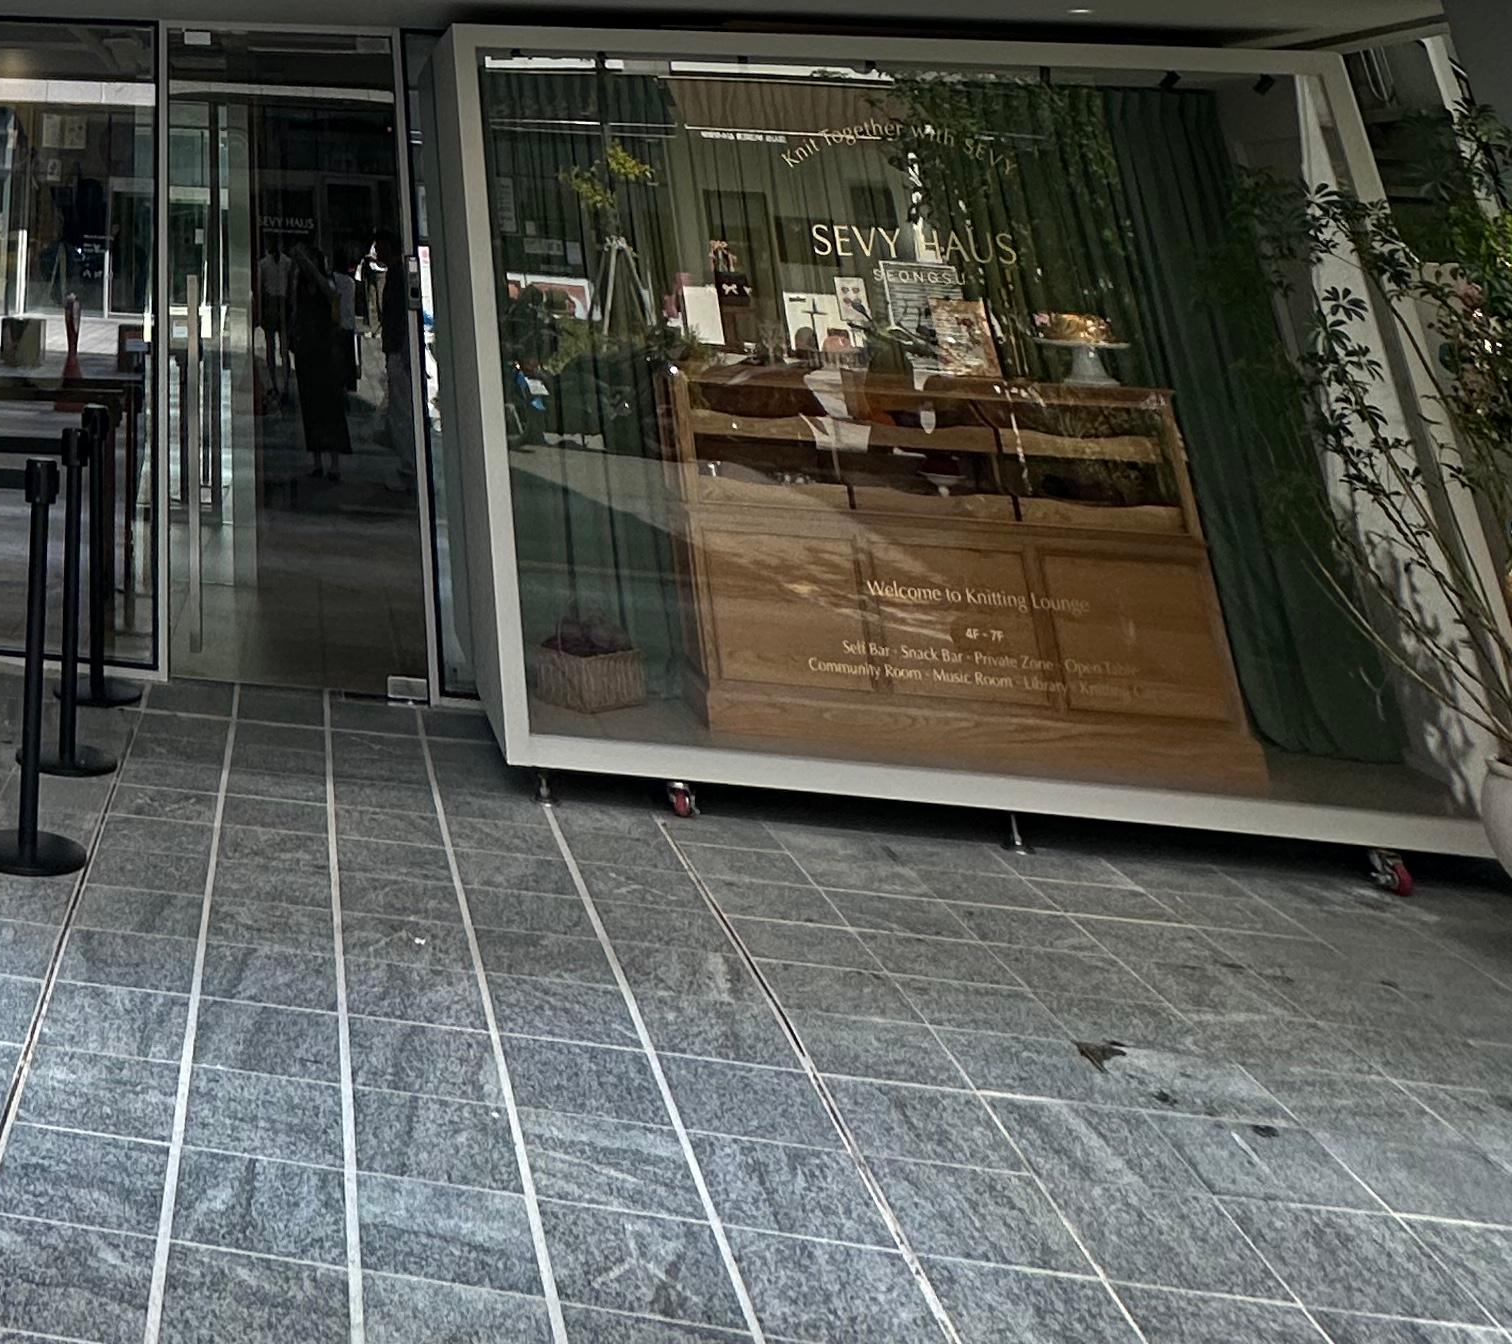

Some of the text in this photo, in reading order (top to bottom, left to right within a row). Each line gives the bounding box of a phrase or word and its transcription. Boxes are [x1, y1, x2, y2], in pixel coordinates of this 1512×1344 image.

[781, 136, 820, 169] Knit
[821, 117, 903, 146] Together
[910, 122, 956, 147] with
[962, 138, 1018, 175] SEVY
[811, 223, 1018, 265] SEVY HAUS
[872, 266, 967, 286] SEONGSU
[866, 579, 1089, 614] Welcome to Knitting Lounge
[965, 627, 980, 641] 4F
[990, 628, 1005, 643] 7F
[842, 639, 866, 656] Self
[869, 642, 890, 658] Bar
[901, 644, 939, 662] Snack
[941, 648, 964, 663] Bar
[974, 651, 1019, 669] Private
[808, 657, 882, 681] Community
[884, 663, 923, 682] Room
[932, 668, 973, 685] Music
[975, 671, 1014, 689] Room
[1023, 674, 1068, 695] Library
